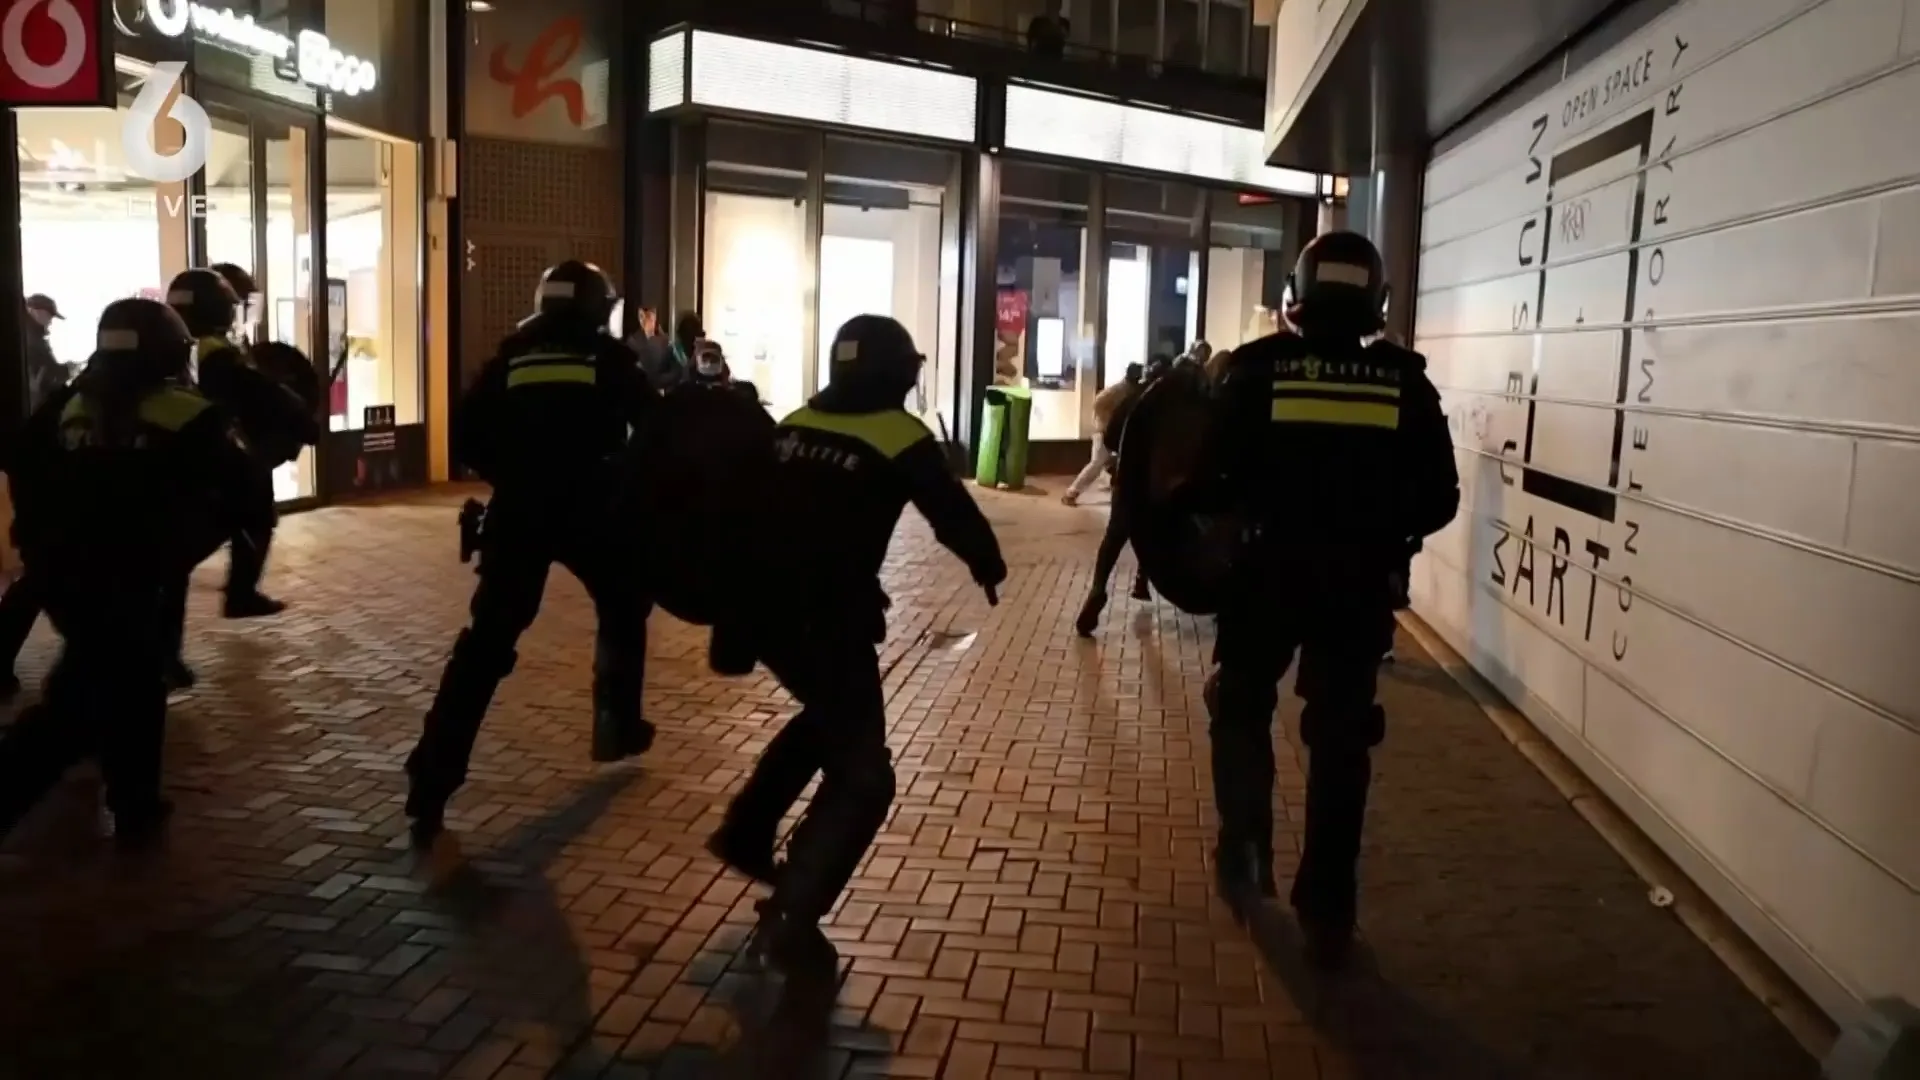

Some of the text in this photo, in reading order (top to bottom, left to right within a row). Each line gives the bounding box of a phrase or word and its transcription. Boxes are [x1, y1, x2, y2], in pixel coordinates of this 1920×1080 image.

[1562, 49, 1654, 128] OPEN SPACE
[1612, 33, 1689, 662] CONTEMPORARY
